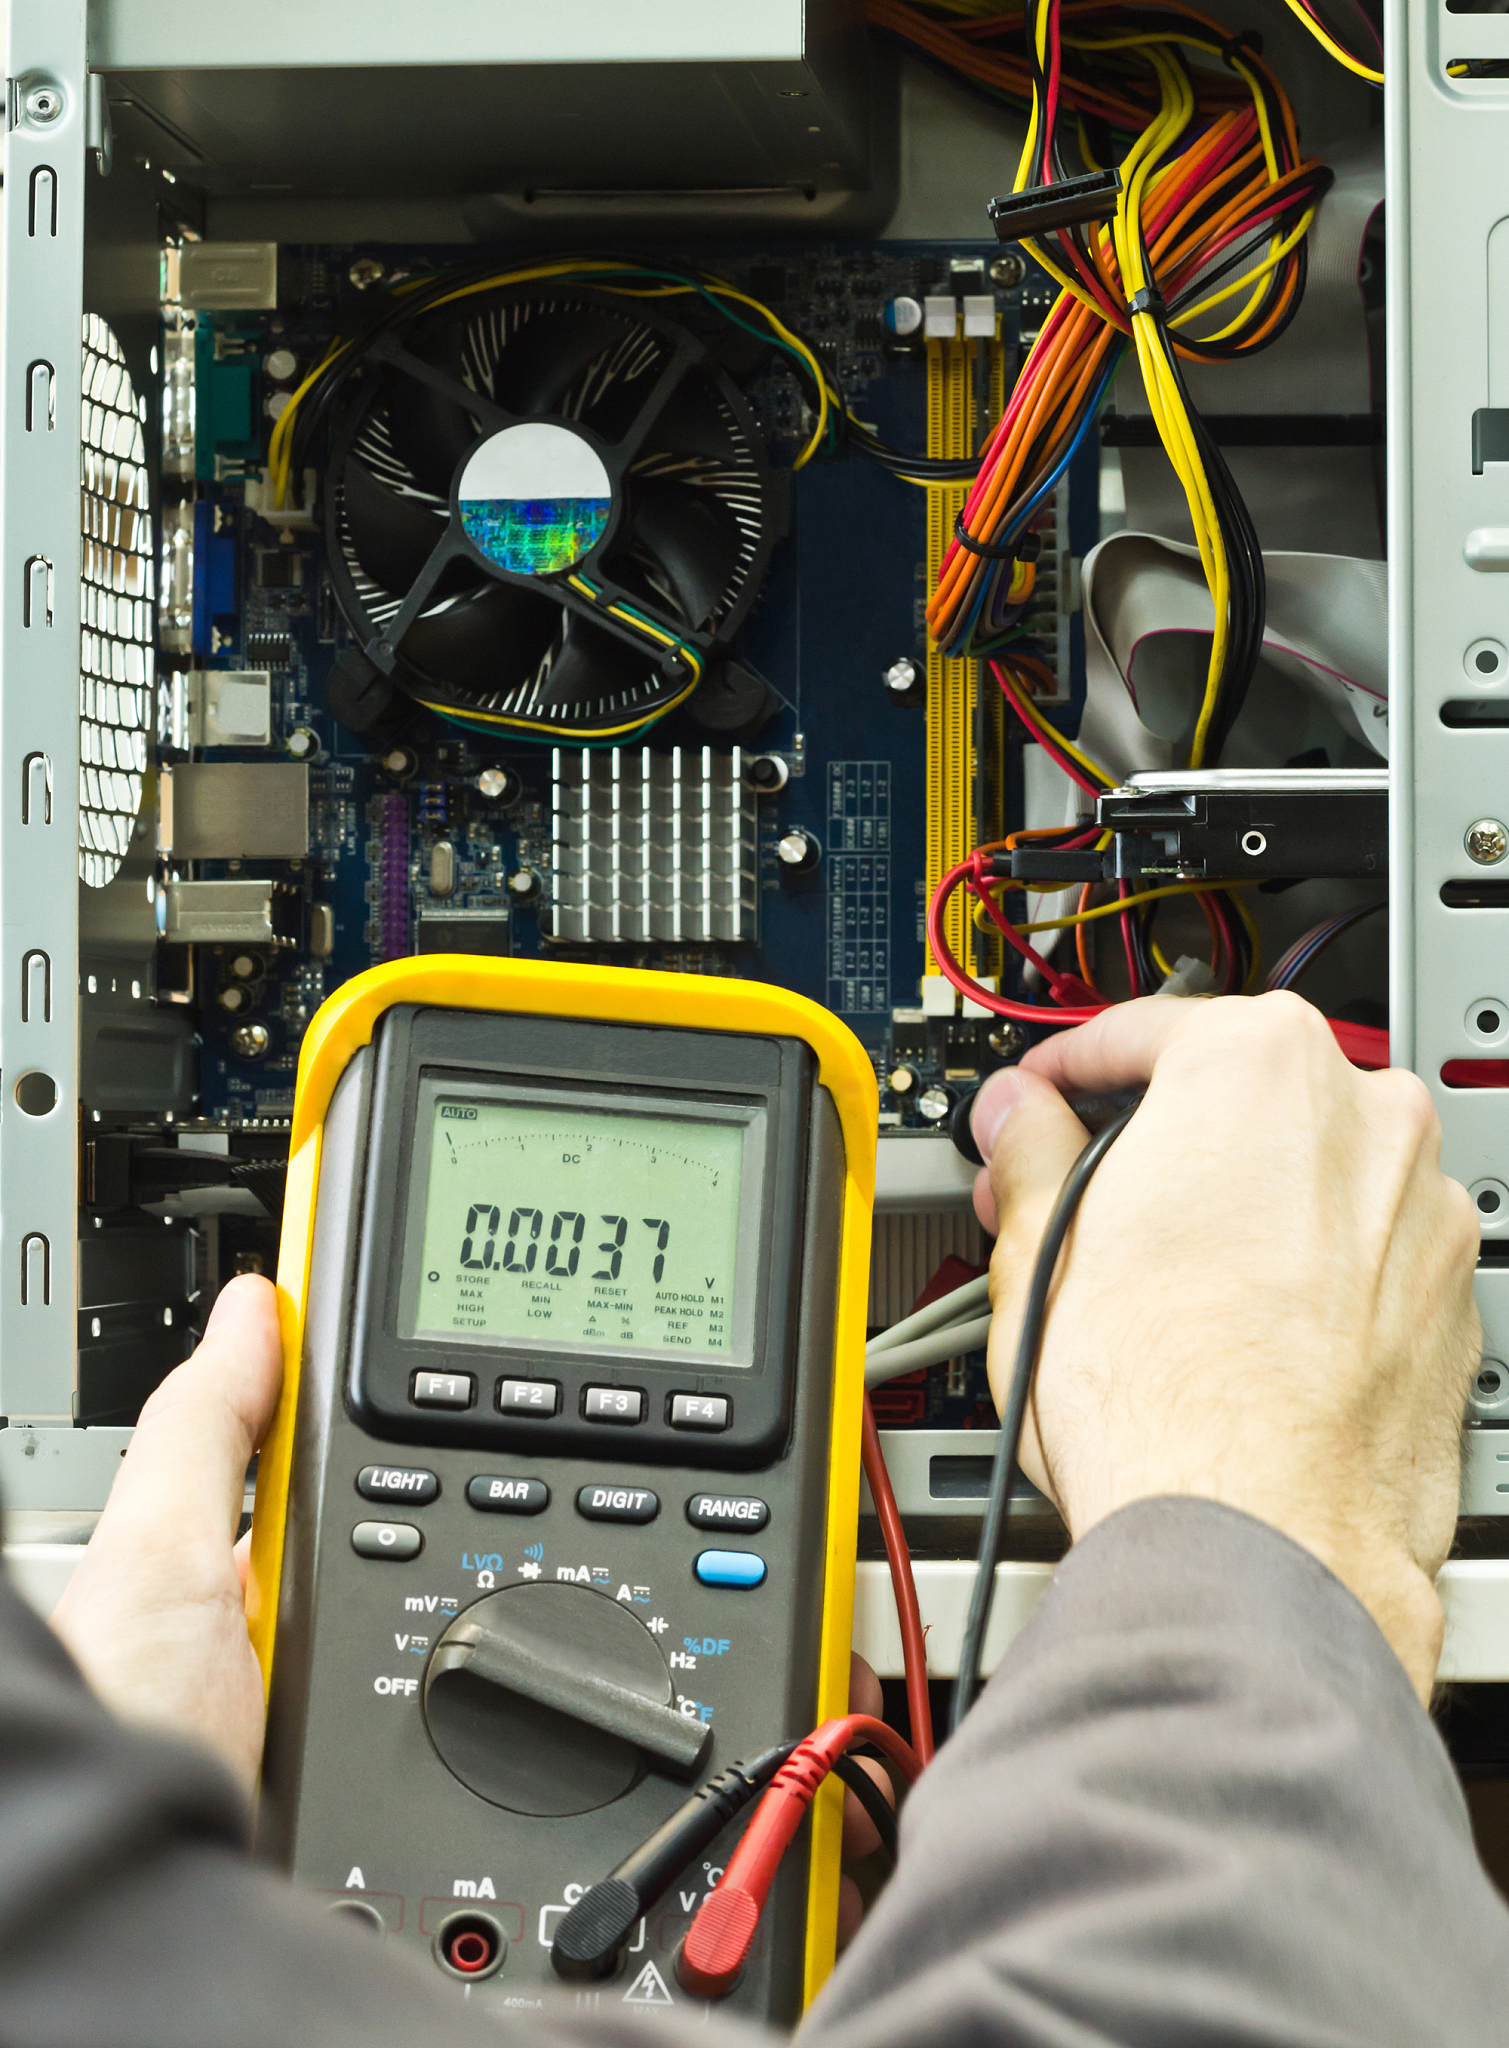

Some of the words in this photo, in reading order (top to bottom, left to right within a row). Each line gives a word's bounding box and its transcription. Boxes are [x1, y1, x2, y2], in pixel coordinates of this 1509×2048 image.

[442, 1107, 477, 1120] AUTO
[562, 1153, 581, 1164] DC
[451, 1157, 458, 1165] 0
[586, 1144, 592, 1152] 2
[651, 1156, 657, 1164] 3
[711, 1179, 719, 1188] 4
[460, 1203, 670, 1284] 0.0037
[456, 1275, 490, 1285] STORE
[521, 1280, 562, 1291] RECALL
[705, 1278, 715, 1289] V
[460, 1289, 483, 1299] MAX
[594, 1287, 627, 1297] RESET
[655, 1292, 679, 1302] AUTO
[681, 1293, 705, 1304] HOLD
[531, 1295, 551, 1305] MIN
[587, 1300, 633, 1312] MAX-MIN
[710, 1295, 725, 1305] M1
[457, 1303, 485, 1313] HIGH
[527, 1309, 552, 1319] LOW
[654, 1305, 677, 1316] PEAK
[679, 1307, 703, 1318] HOLD
[710, 1310, 724, 1319] M2
[452, 1317, 487, 1327] SETUP
[667, 1321, 689, 1330] REF
[709, 1324, 723, 1333] M3
[583, 1328, 606, 1338] dBm
[620, 1331, 634, 1340] dB
[662, 1335, 692, 1345] SEND
[708, 1338, 723, 1347] M4
[428, 1378, 457, 1396] F1
[513, 1387, 543, 1404] F2
[599, 1394, 628, 1412] F3
[685, 1401, 714, 1419] F4
[370, 1470, 429, 1492] LIGHT
[488, 1481, 529, 1500] BAR
[591, 1490, 648, 1510] DIGIT
[697, 1498, 760, 1520] RANGE
[557, 1565, 592, 1582] mA
[616, 1584, 633, 1602] A
[405, 1595, 440, 1613] mV
[394, 1635, 409, 1652] V
[683, 1637, 731, 1657] %DF
[670, 1651, 697, 1670] Hz
[373, 1677, 419, 1697] OFF
[346, 1866, 366, 1889] A
[453, 1876, 496, 1900] mA
[503, 1997, 543, 2010] 400mA
